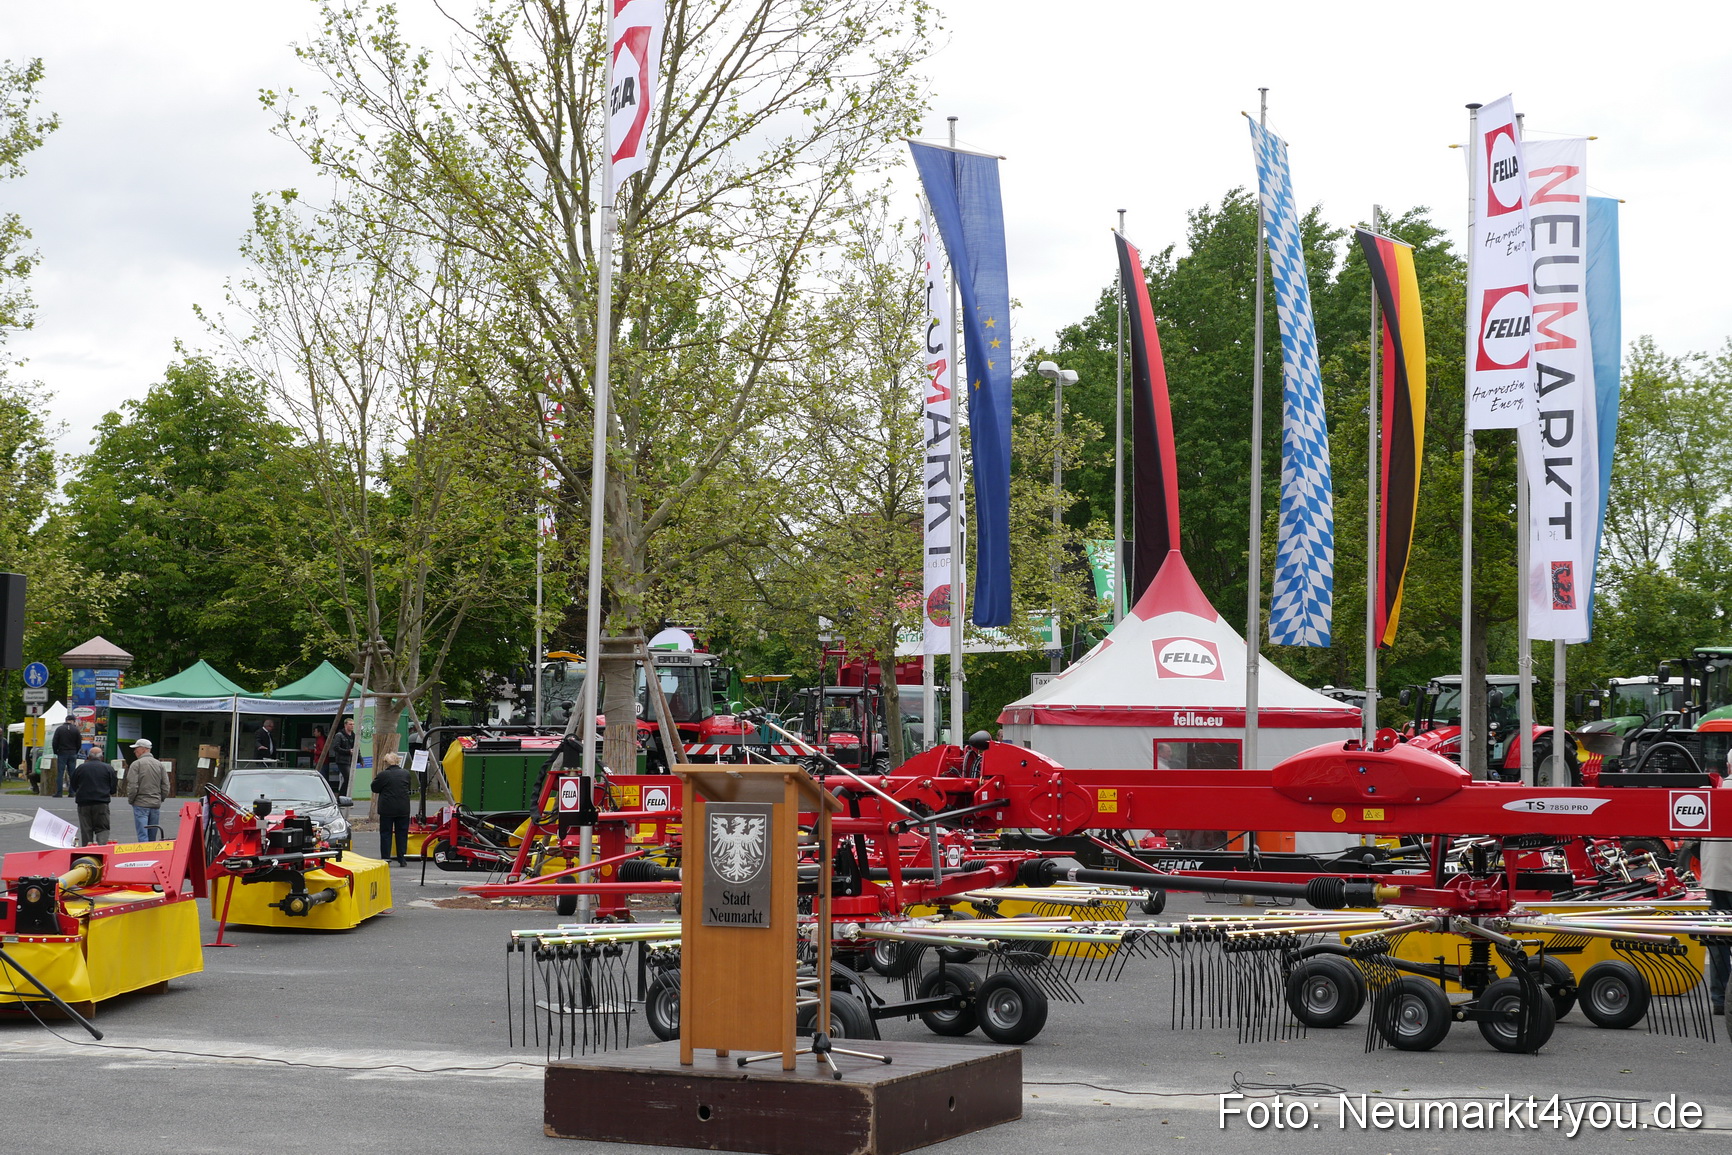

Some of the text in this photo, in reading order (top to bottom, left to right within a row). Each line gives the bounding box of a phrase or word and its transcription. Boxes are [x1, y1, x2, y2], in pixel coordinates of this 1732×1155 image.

[1492, 155, 1519, 184] FELLA
[1484, 315, 1530, 339] FELLA
[1528, 164, 1582, 540] NEUMARKT
[1472, 380, 1526, 403] Harvestin
[1490, 396, 1524, 412] Energ
[1162, 652, 1215, 666] FELLA
[1173, 712, 1224, 727] fella.eu
[562, 790, 577, 799] FELLA
[646, 798, 666, 807] FELLA
[1525, 801, 1546, 811] TS
[1675, 806, 1705, 815] FELLA
[1157, 859, 1199, 871] FELLA
[722, 890, 751, 906] Stadt
[709, 907, 763, 924] Neumarkt
